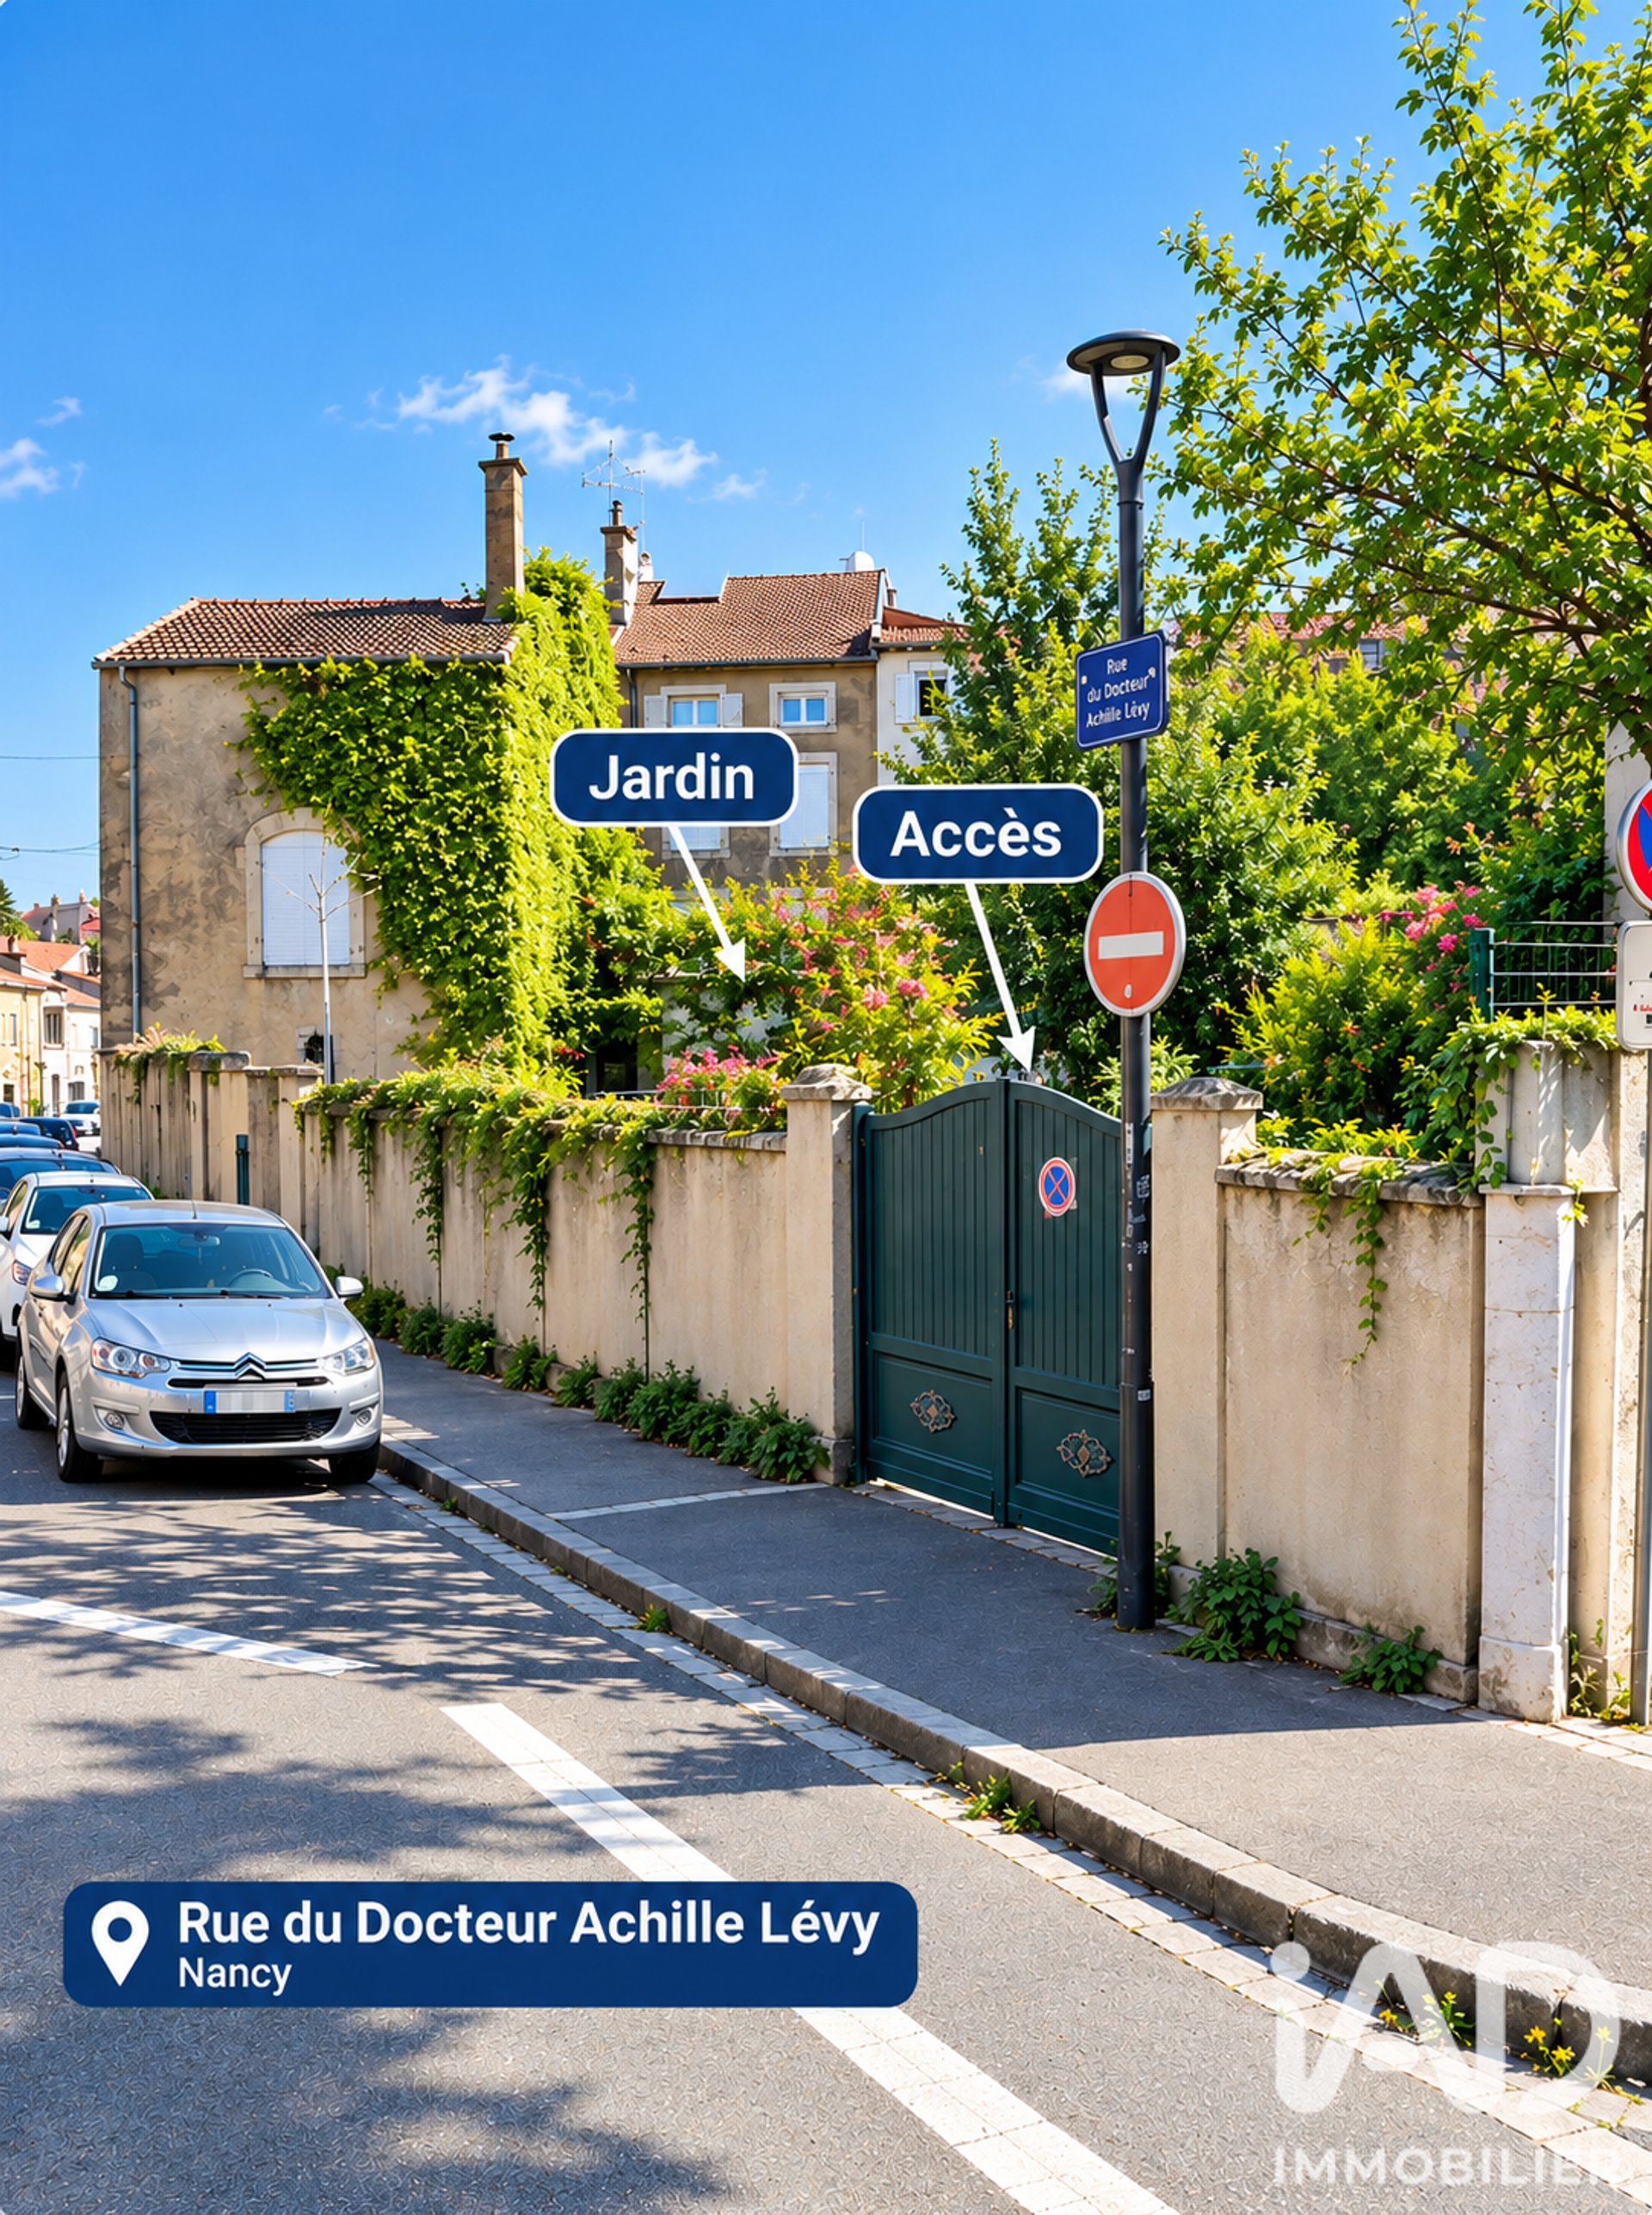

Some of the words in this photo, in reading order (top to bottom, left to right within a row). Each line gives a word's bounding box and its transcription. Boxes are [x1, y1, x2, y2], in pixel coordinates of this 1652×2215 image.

[1106, 658, 1128, 675] Rue
[1088, 687, 1101, 703] du
[1105, 676, 1150, 699] Docteur
[1086, 706, 1122, 728] Achille
